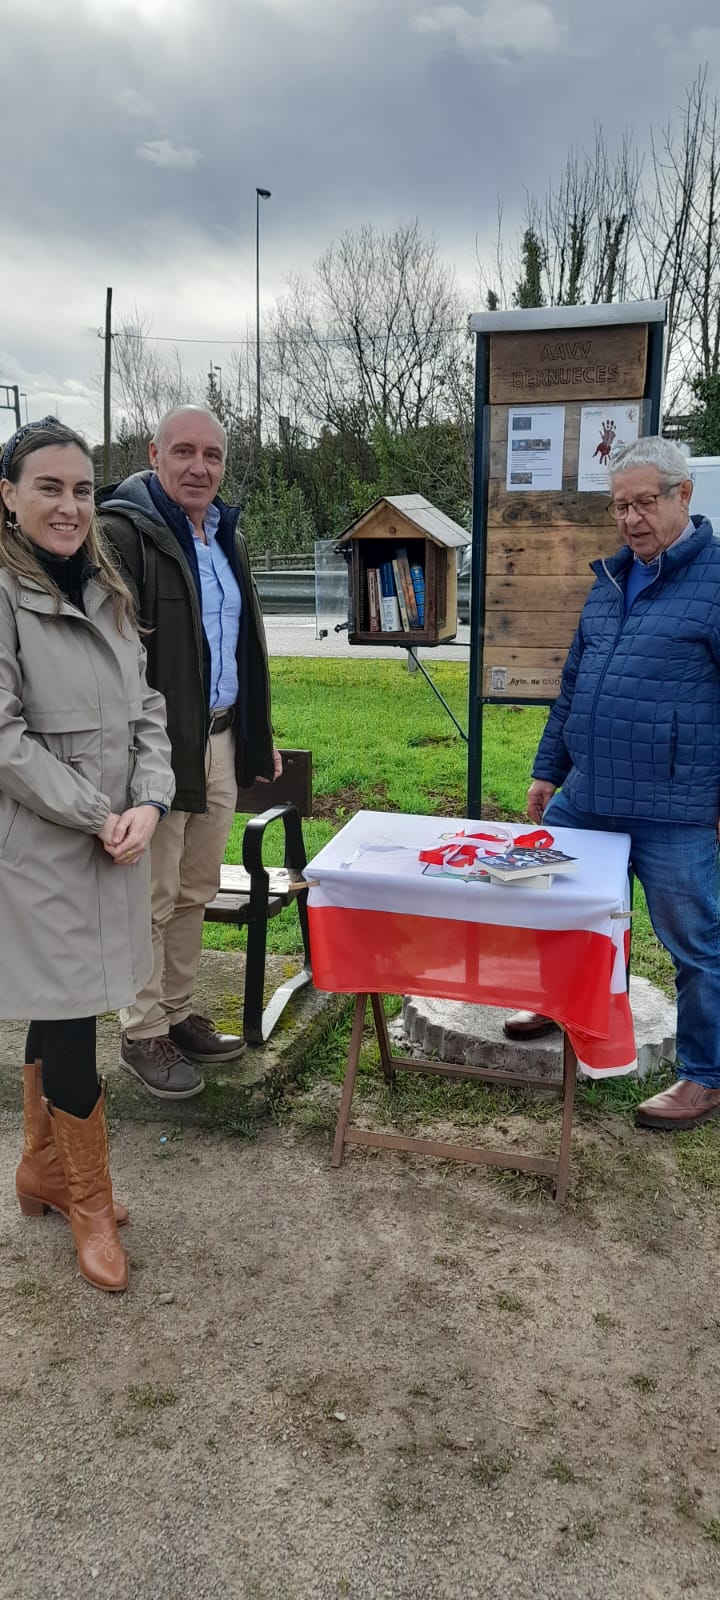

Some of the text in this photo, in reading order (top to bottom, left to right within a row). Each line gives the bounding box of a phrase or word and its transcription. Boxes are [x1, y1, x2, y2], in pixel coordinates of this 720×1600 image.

[541, 341, 591, 361] AAVV
[512, 365, 619, 388] BERNUECES
[542, 678, 560, 686] GIJO
